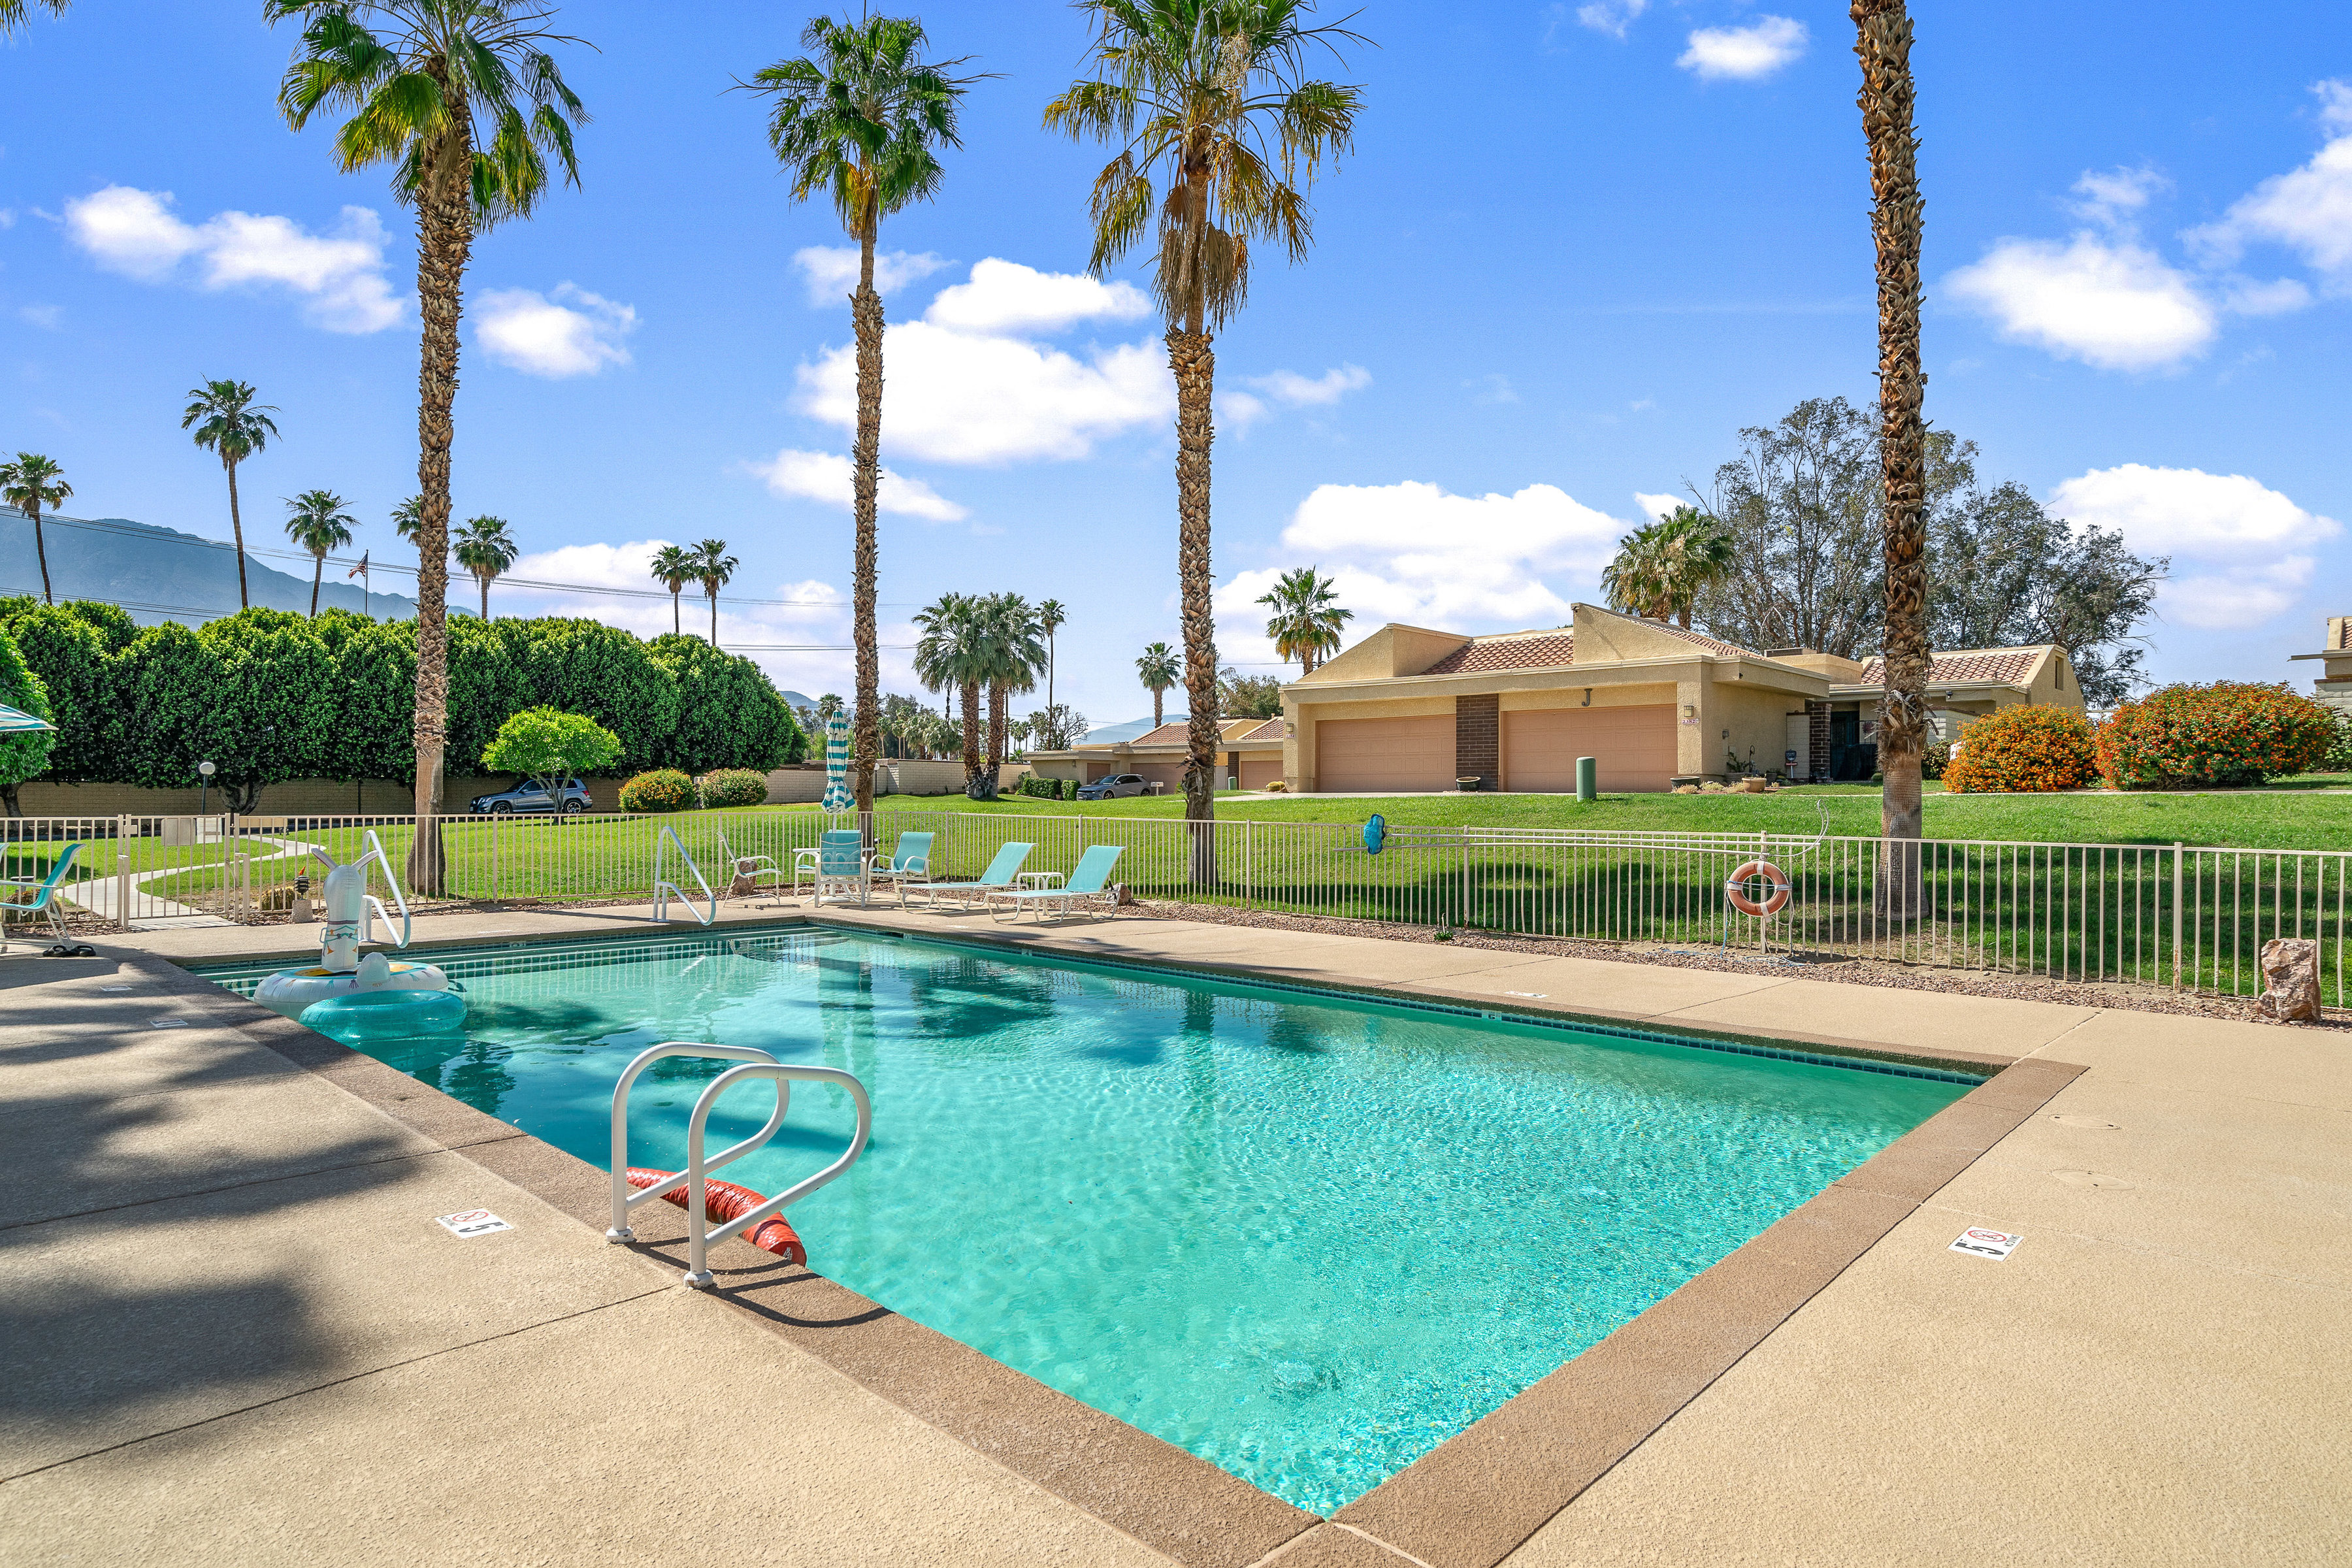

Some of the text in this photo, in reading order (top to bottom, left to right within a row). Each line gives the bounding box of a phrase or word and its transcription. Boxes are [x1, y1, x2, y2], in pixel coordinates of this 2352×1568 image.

[1582, 688, 1593, 707] J
[459, 1222, 504, 1232] 5
[1955, 1242, 2004, 1255] 5
